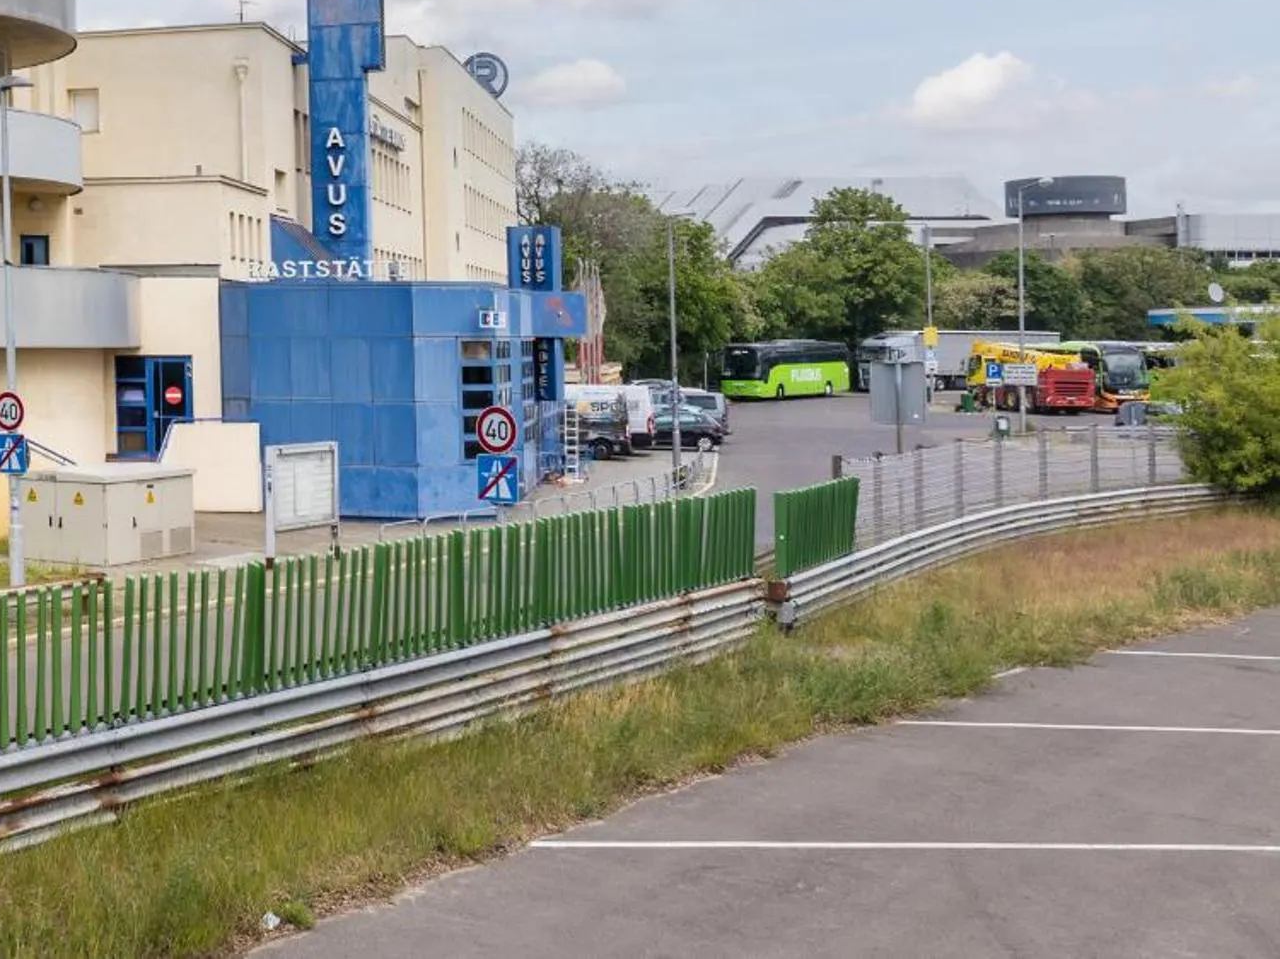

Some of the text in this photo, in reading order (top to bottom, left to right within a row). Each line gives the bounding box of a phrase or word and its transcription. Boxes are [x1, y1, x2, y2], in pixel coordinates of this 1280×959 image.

[326, 127, 347, 235] AVUS
[521, 233, 532, 283] AVUS
[535, 233, 545, 282] AVUS
[989, 365, 998, 376] P
[0, 402, 18, 421] 40
[485, 419, 509, 441] 40
